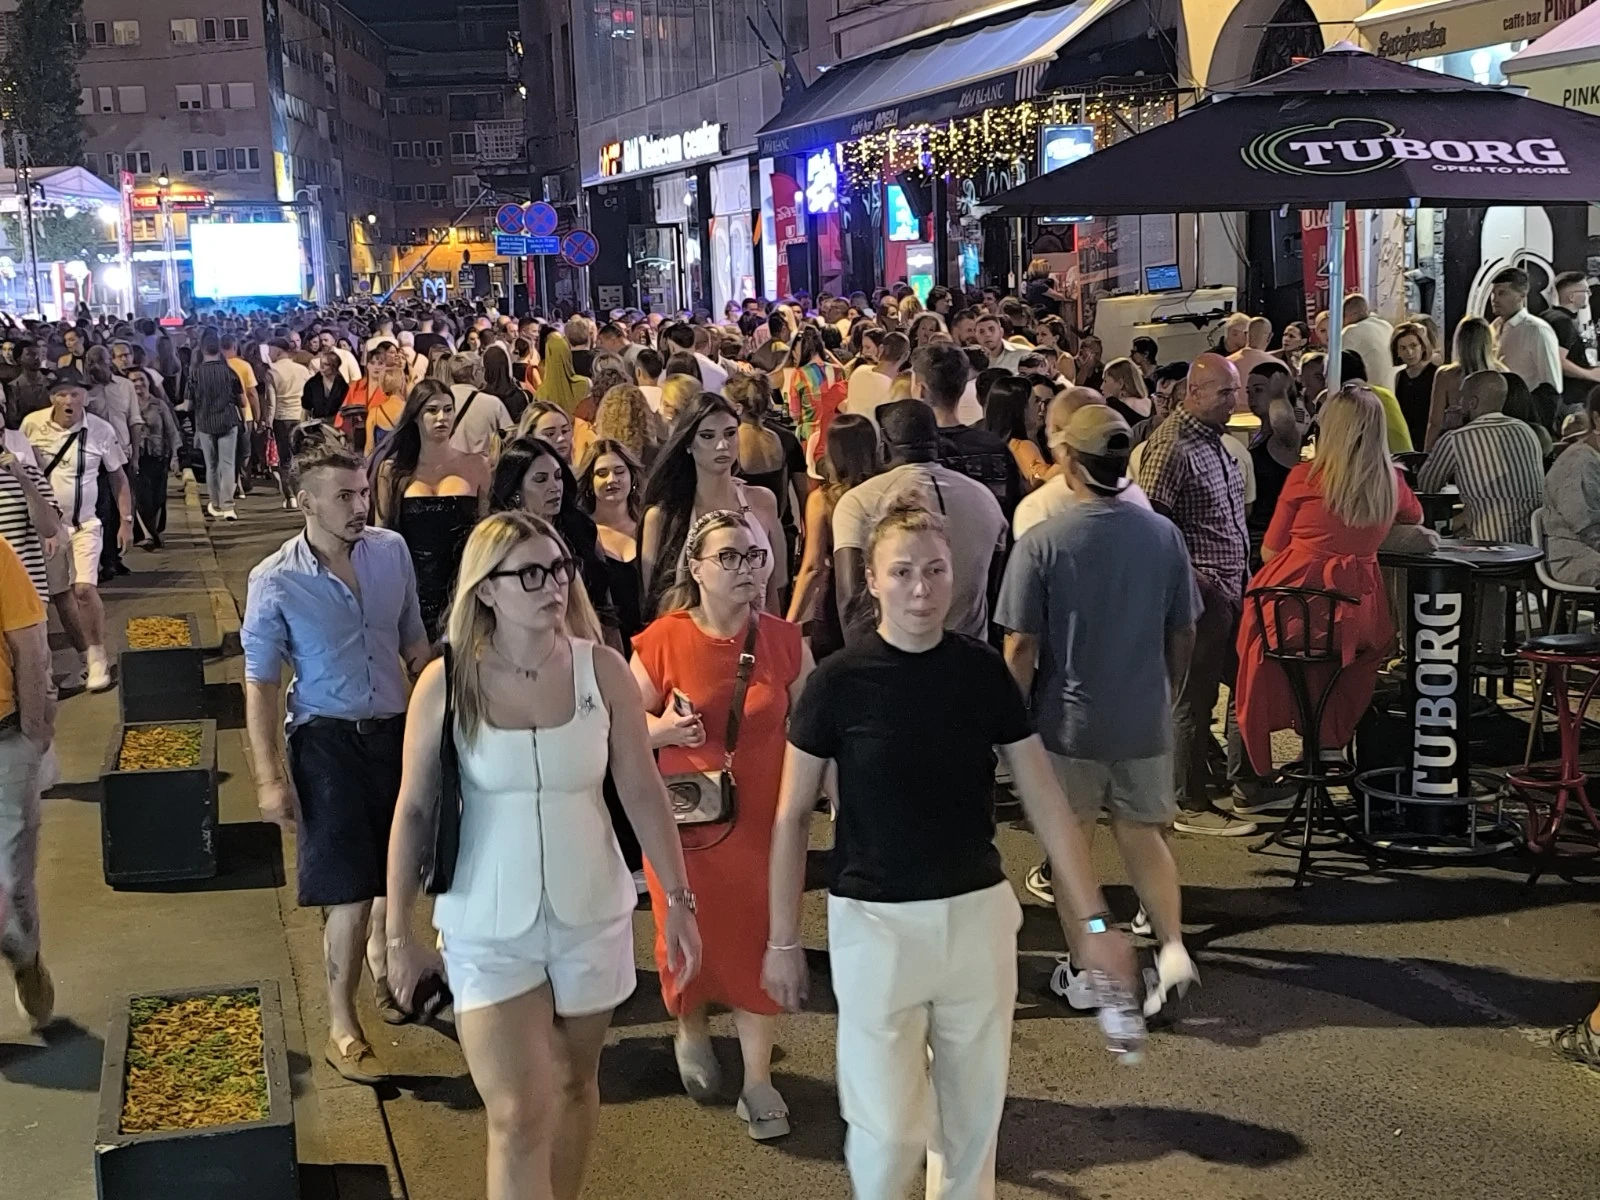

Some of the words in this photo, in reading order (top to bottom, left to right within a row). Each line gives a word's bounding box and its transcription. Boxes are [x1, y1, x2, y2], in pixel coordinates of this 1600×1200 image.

[1527, 11, 1541, 26] bar
[975, 82, 1005, 105] BLANC
[1563, 85, 1600, 108] PINK
[639, 132, 682, 169] Telecom
[1289, 138, 1567, 166] TUBORG
[1431, 164, 1483, 173] OPEN
[1412, 592, 1463, 798] TUBORG
